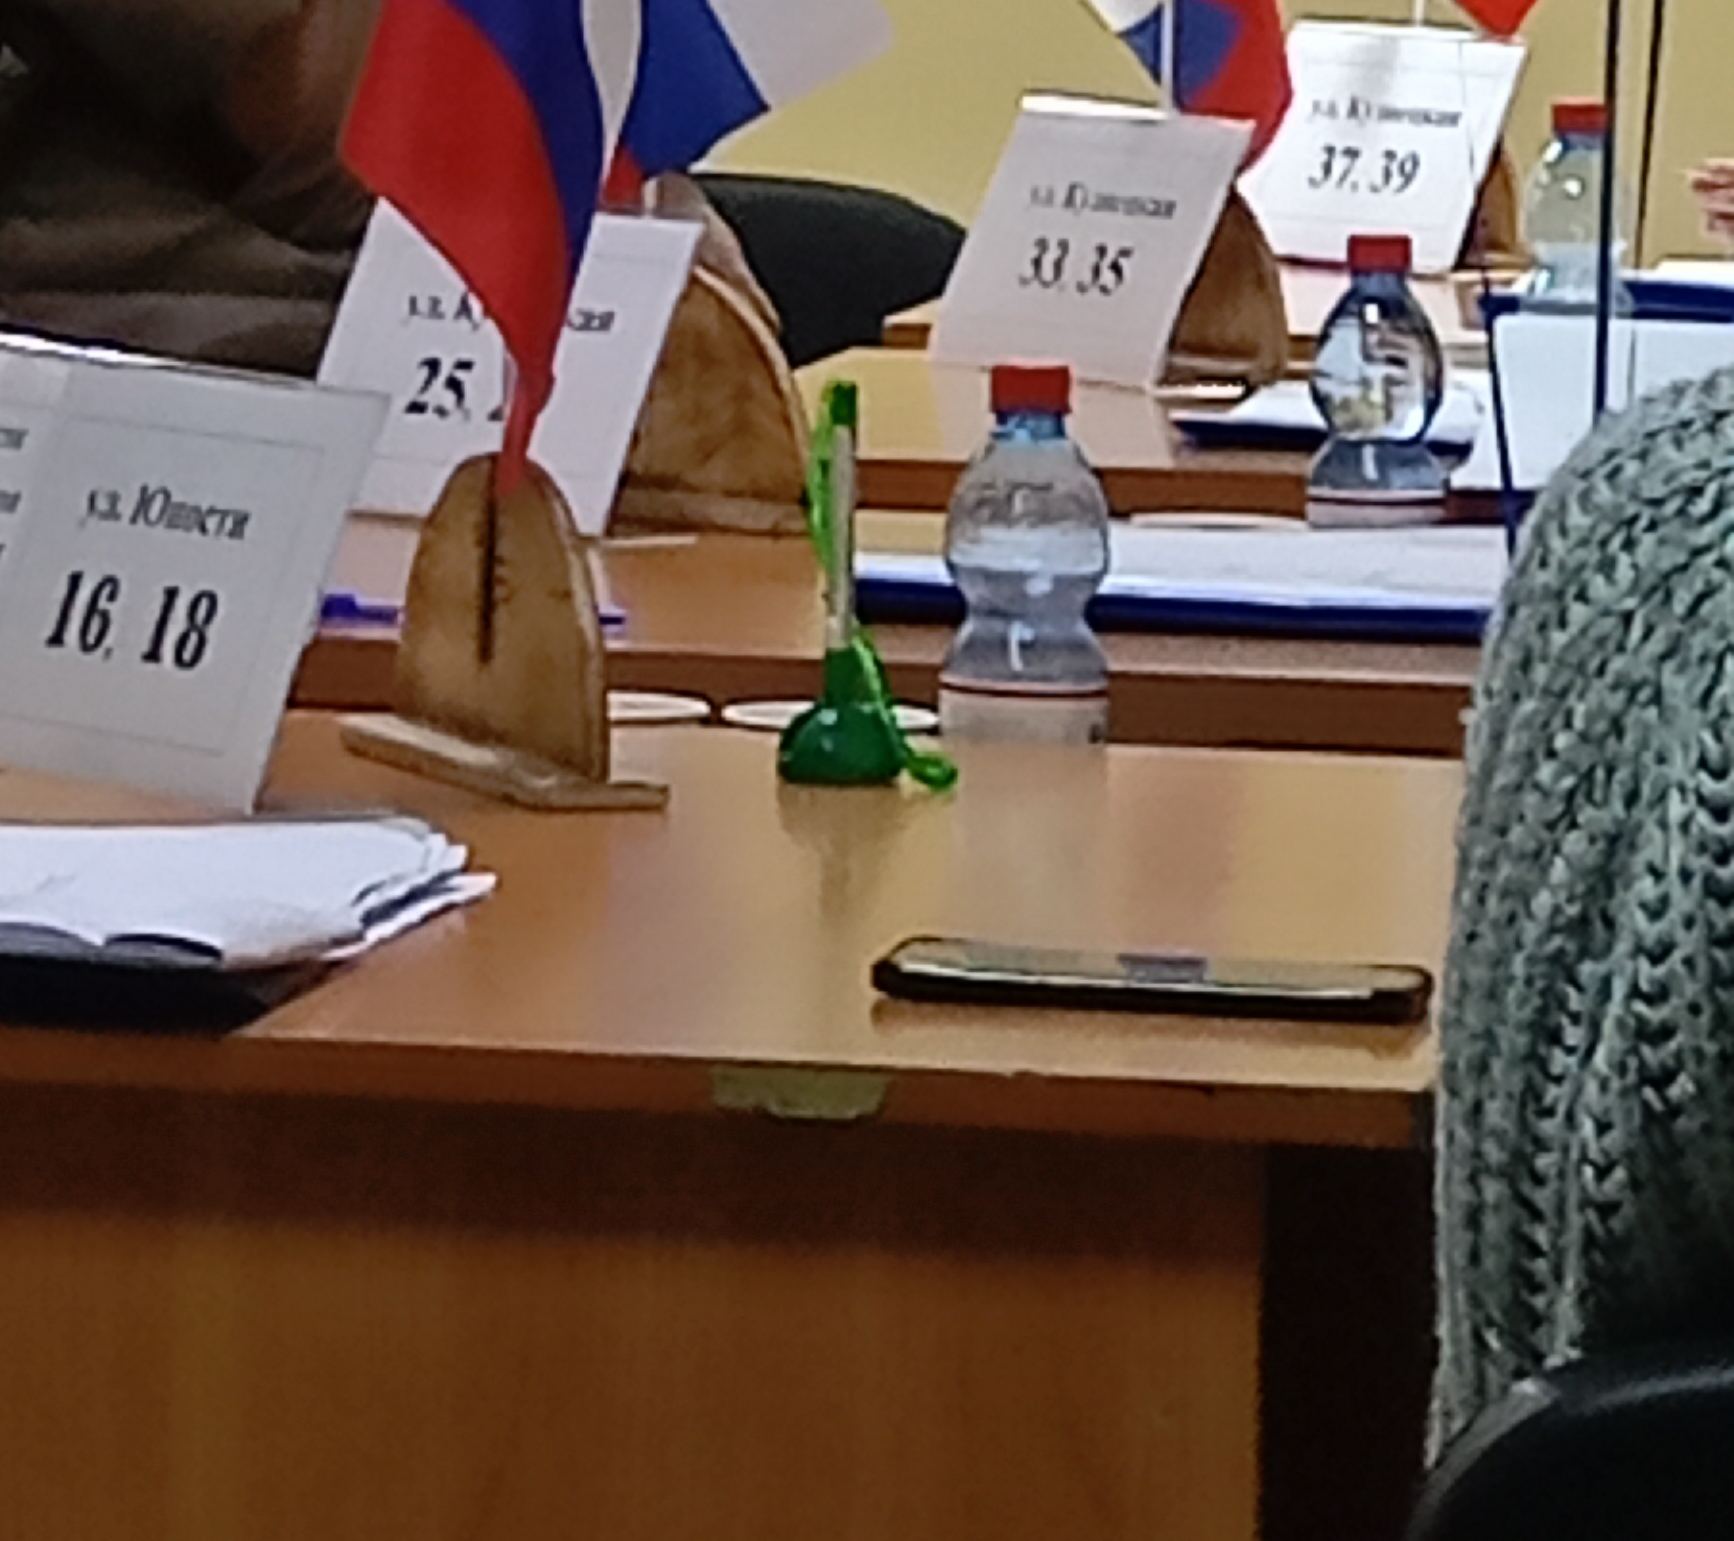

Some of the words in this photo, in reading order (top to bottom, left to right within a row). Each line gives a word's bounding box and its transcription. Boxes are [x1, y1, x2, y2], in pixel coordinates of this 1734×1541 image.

[1368, 149, 1420, 194] 39
[1076, 243, 1134, 296] 35
[141, 585, 218, 670] 18
